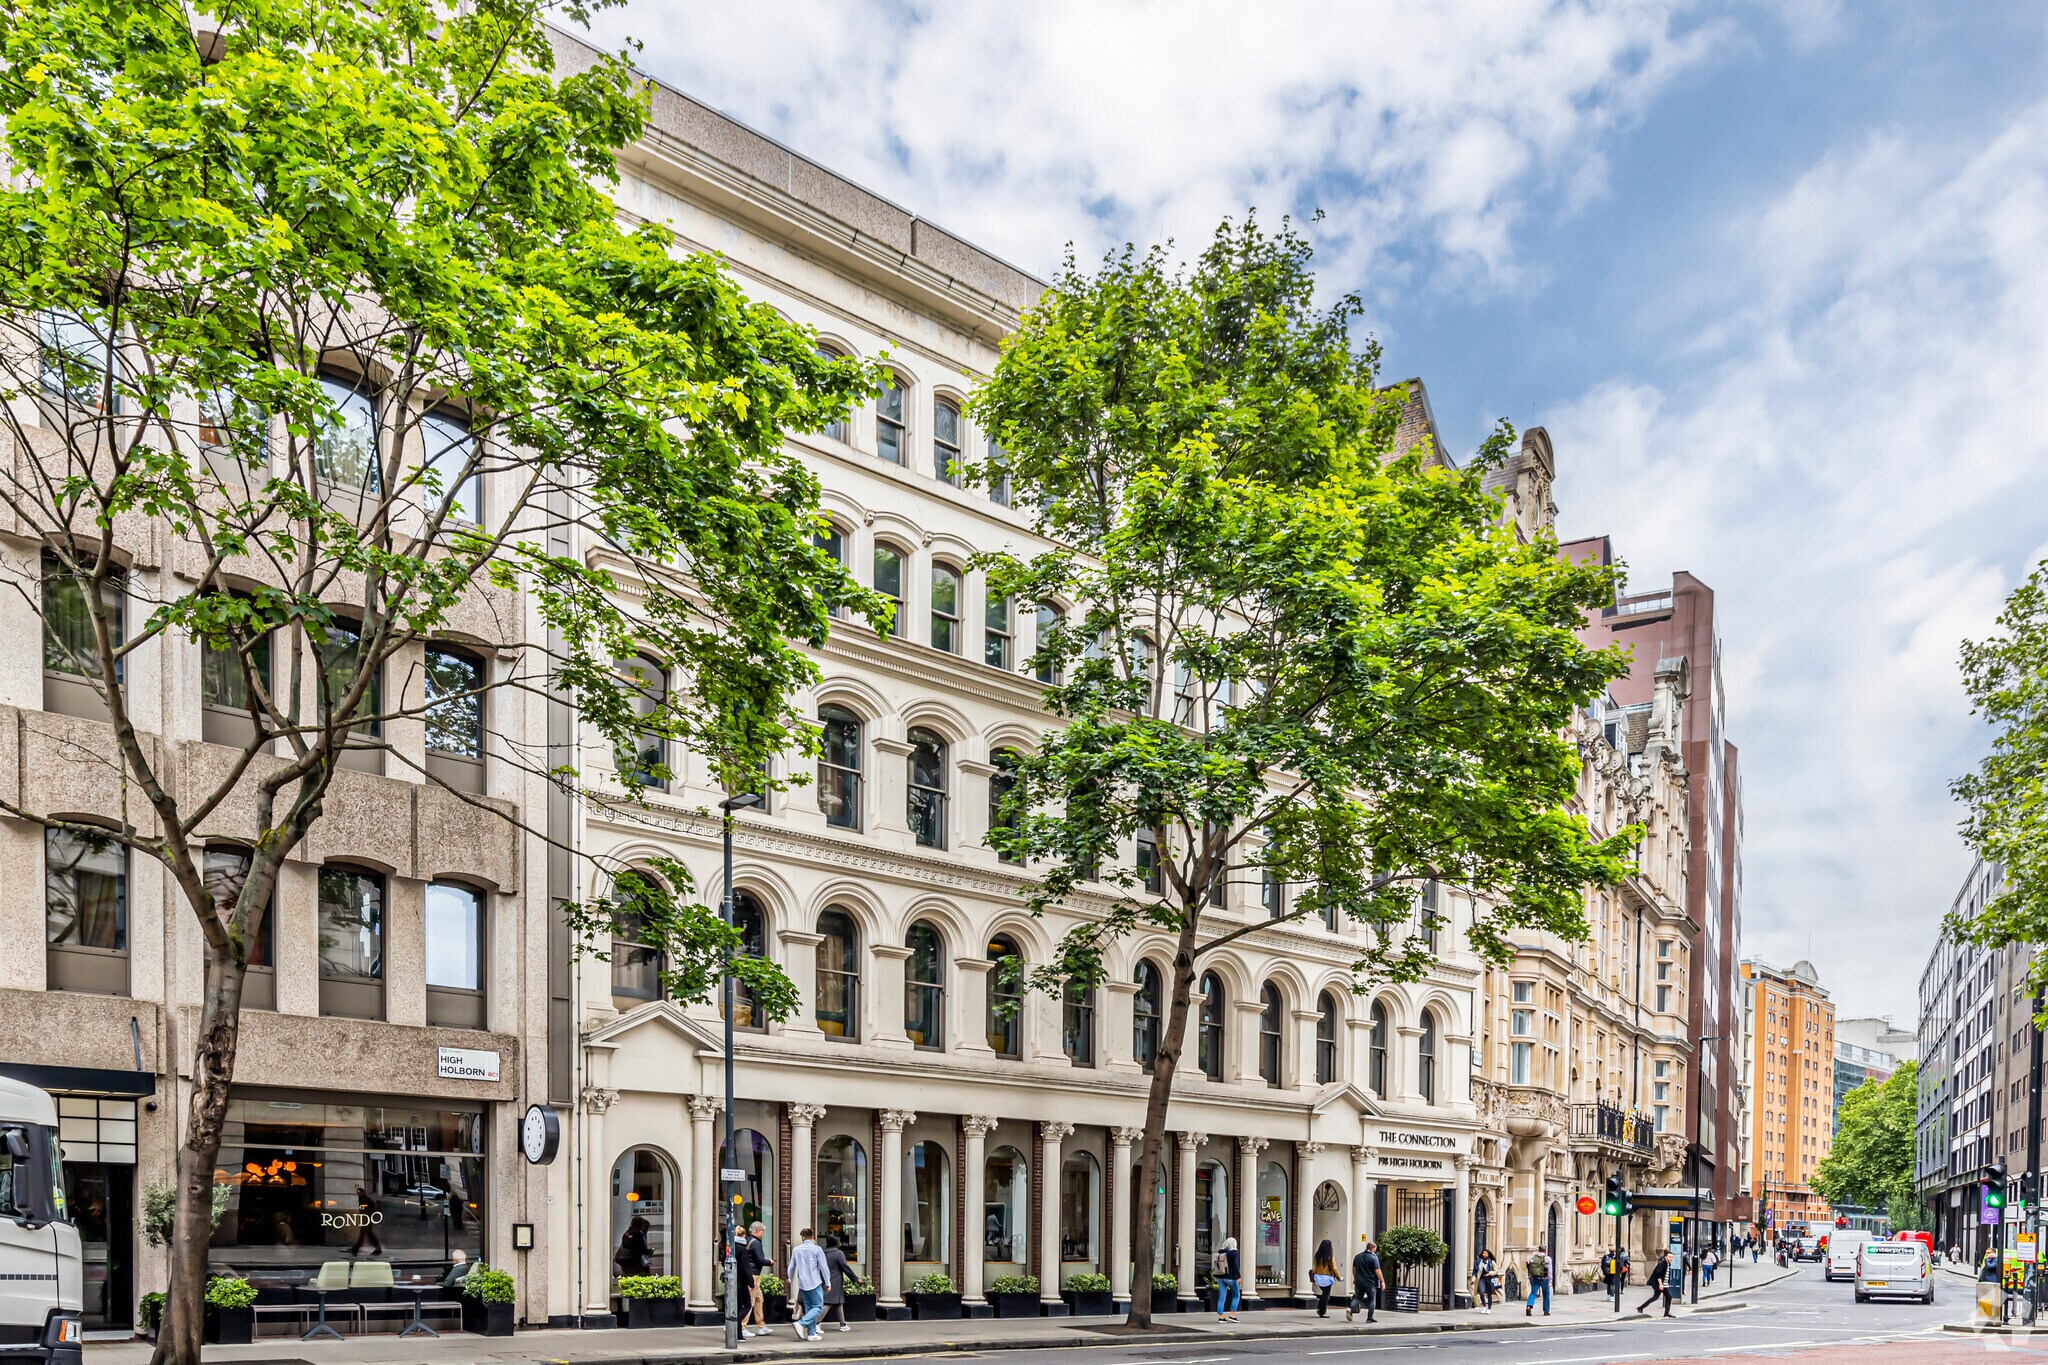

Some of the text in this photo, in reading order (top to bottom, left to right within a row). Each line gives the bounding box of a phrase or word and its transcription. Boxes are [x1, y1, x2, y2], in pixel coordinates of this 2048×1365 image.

[440, 1055, 463, 1065] HIGH
[440, 1066, 486, 1077] HOLBORN
[1379, 1131, 1456, 1148] THE CONNECTION
[1378, 1157, 1443, 1170] 198 HIGH HOLBORN
[1260, 1200, 1271, 1210] LA
[320, 1211, 383, 1229] RONDO
[1261, 1210, 1283, 1222] CAVE
[1869, 1247, 1914, 1255] enterprise
